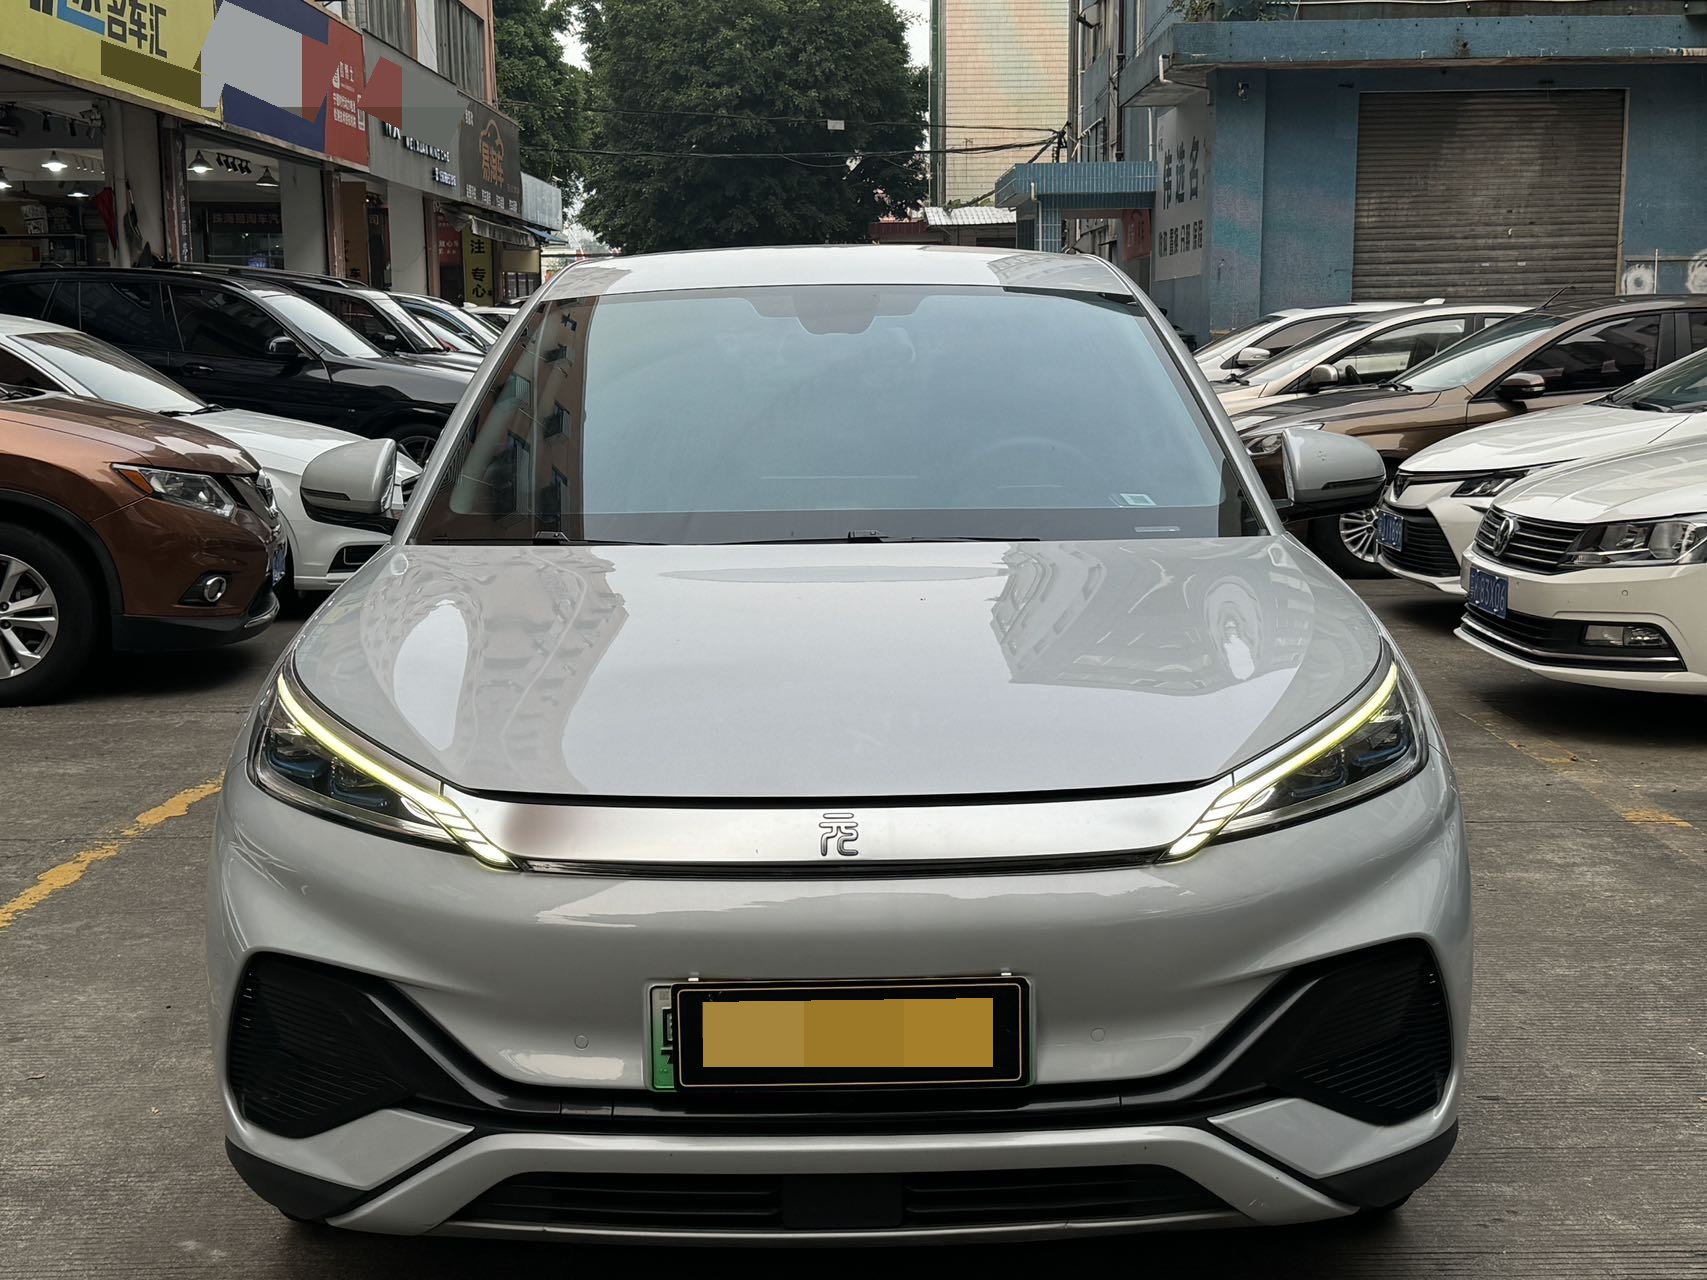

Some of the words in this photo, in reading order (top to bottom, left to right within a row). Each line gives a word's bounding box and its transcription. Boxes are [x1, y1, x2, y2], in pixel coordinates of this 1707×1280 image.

[1163, 136, 1204, 210] 伟选名
[471, 267, 487, 298] 专心
[819, 812, 858, 857] 元
